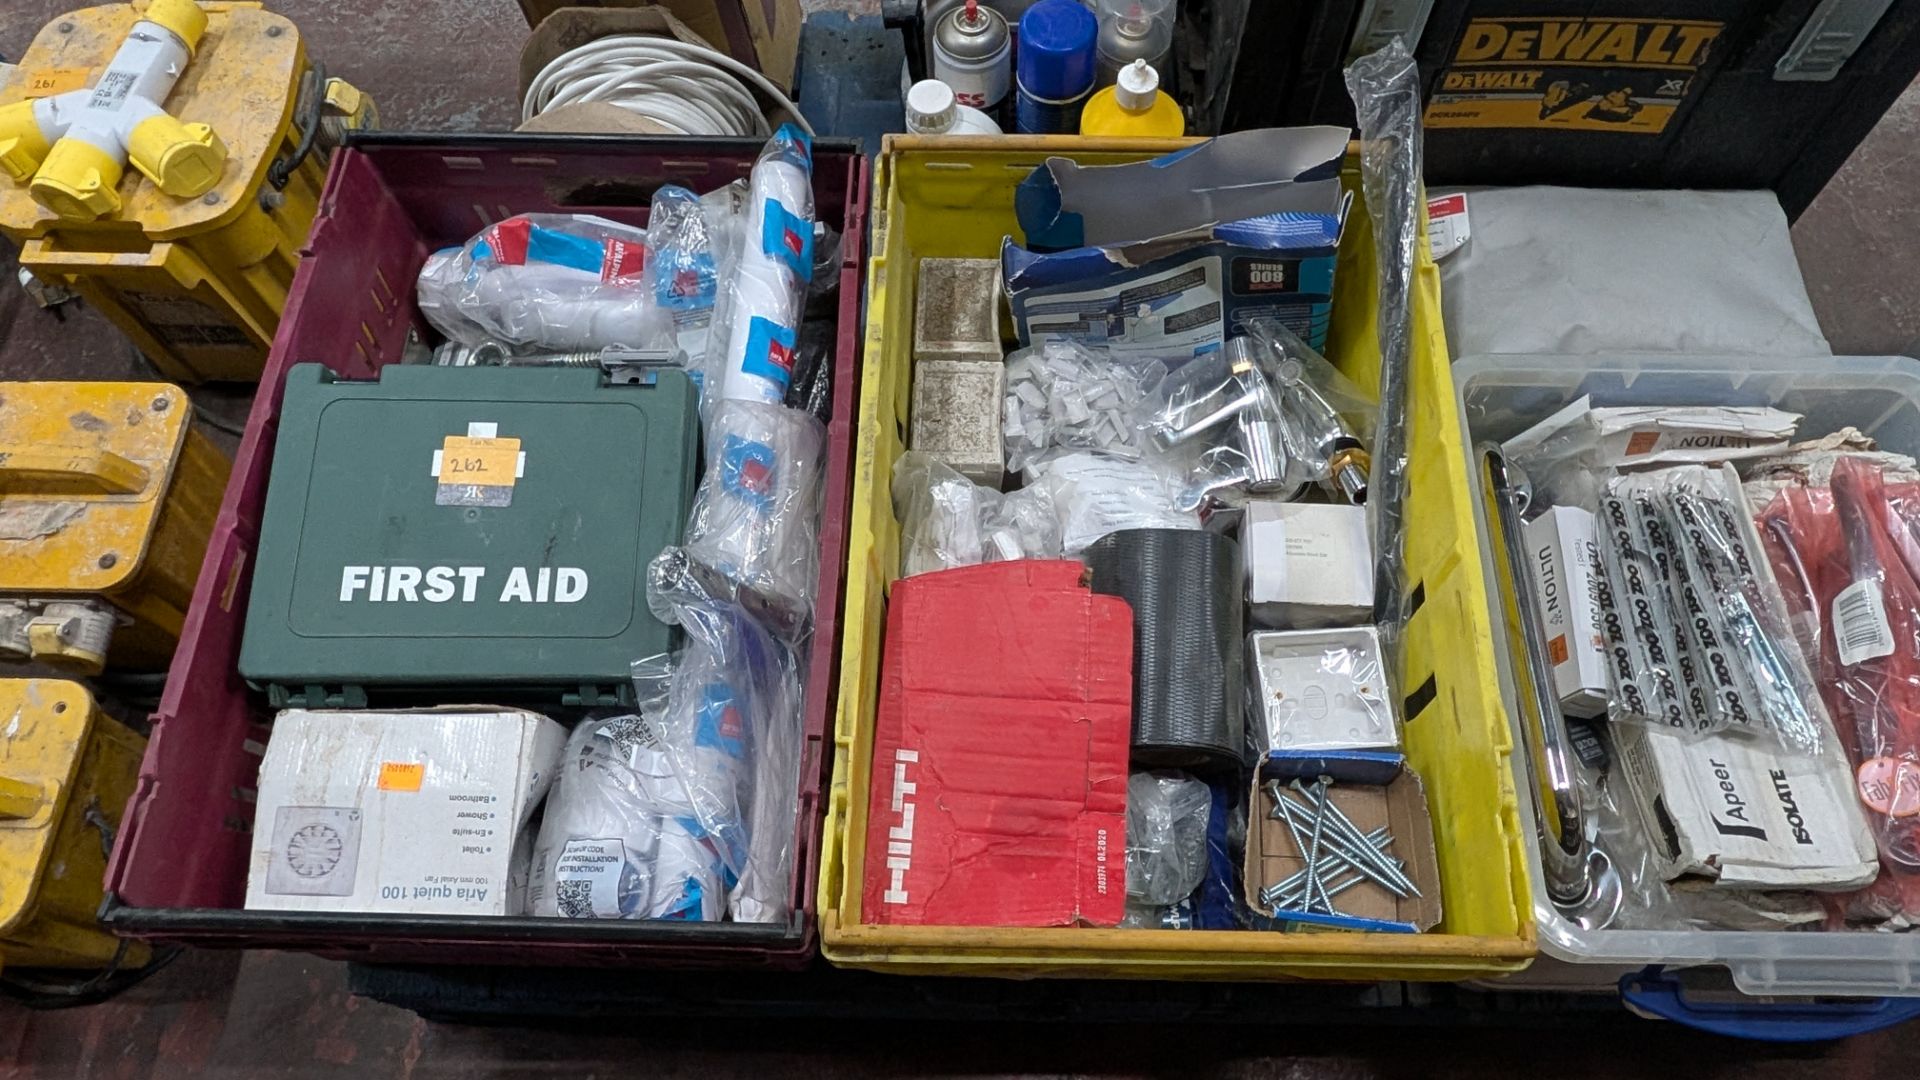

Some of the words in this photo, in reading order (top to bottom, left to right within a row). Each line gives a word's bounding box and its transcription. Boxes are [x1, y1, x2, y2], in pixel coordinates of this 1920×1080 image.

[1455, 22, 1719, 63] DEWALT
[1442, 71, 1543, 91] DEWALT
[956, 93, 985, 107] SS
[1250, 271, 1283, 283] 800
[450, 458, 488, 473] 262
[340, 566, 485, 602] FIRST
[500, 567, 588, 603] AID
[1539, 545, 1559, 613] ULTION
[1709, 758, 1749, 822] Apeer
[448, 794, 490, 804] Bathroom
[1768, 769, 1814, 845] ISOLATE
[456, 811, 489, 821] Shower
[884, 748, 919, 904] HILTI
[462, 845, 485, 854] Toilet
[382, 885, 407, 900] 100
[413, 884, 452, 901] quiet
[457, 888, 488, 902] Aria
